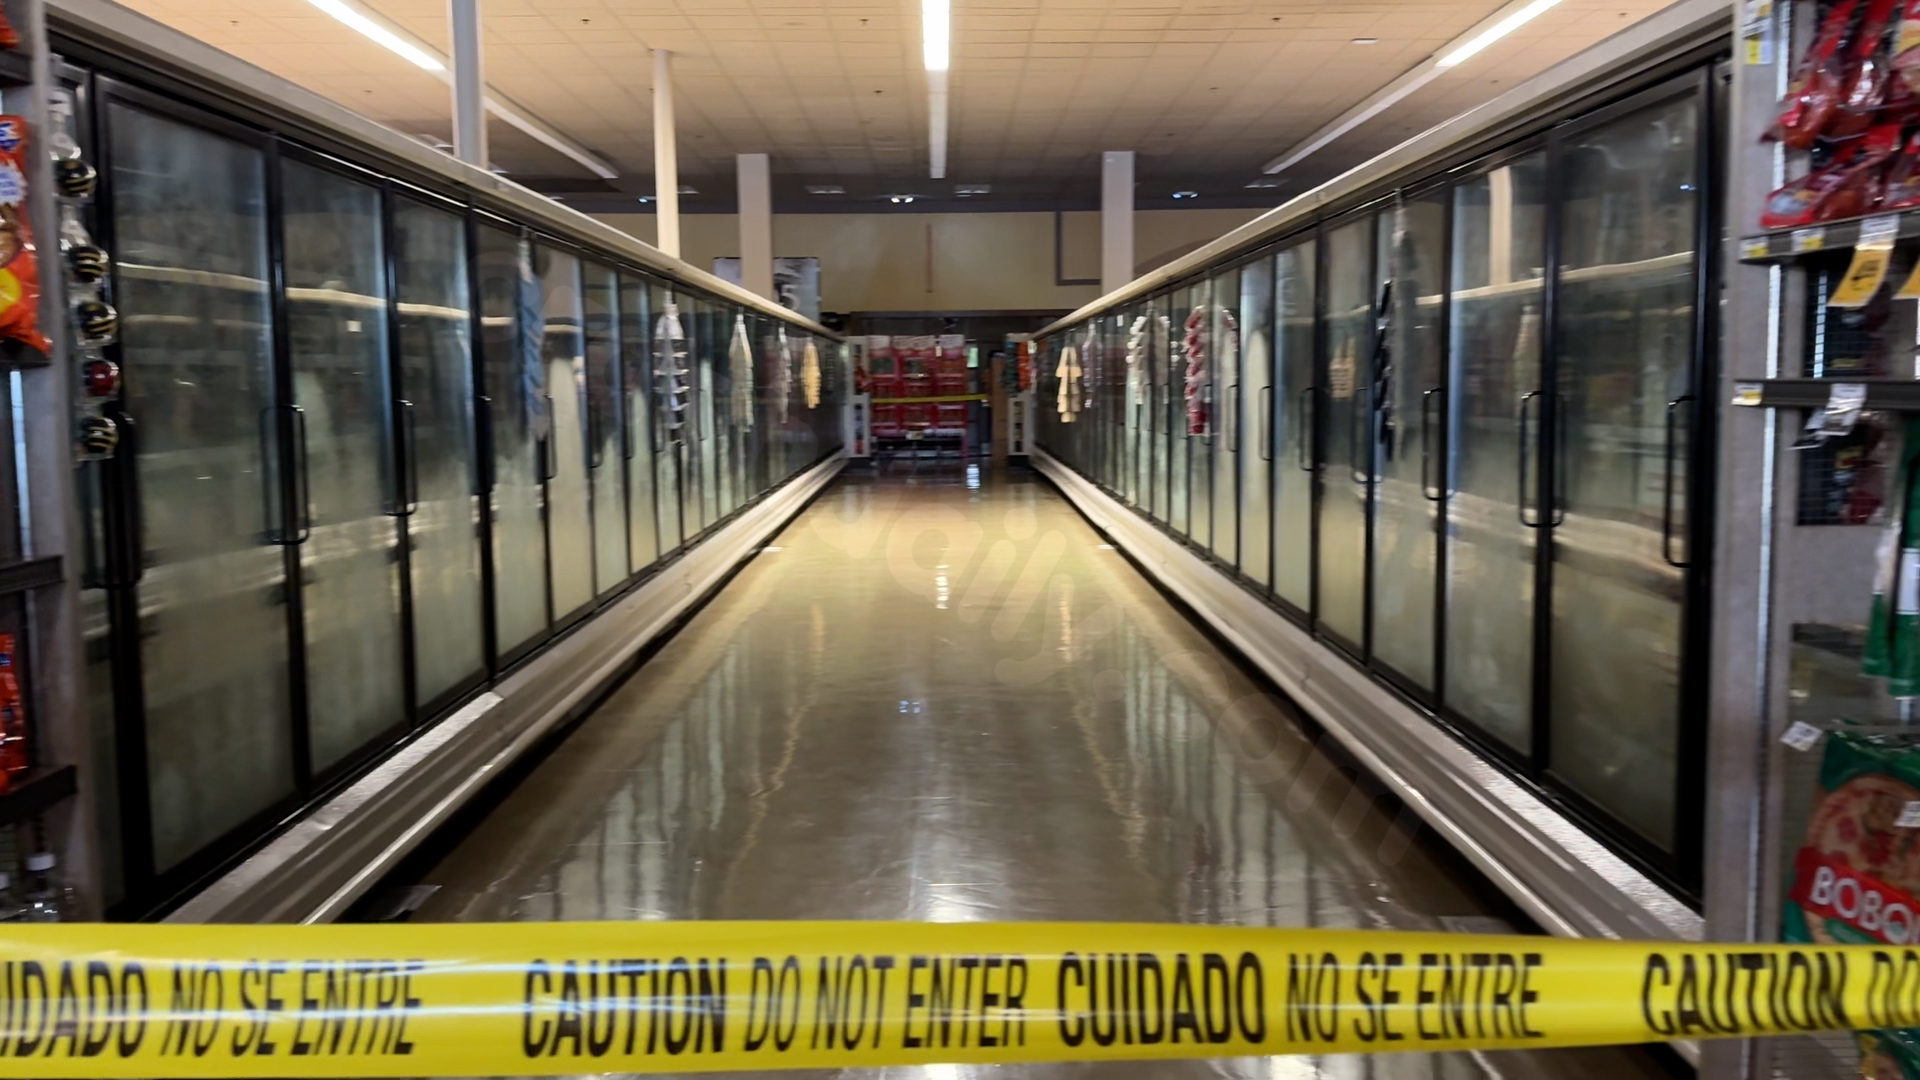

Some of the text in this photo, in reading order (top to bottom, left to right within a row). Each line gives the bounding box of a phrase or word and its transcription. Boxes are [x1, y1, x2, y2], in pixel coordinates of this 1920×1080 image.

[162, 962, 224, 1057] NO
[231, 960, 288, 1056] SE
[290, 959, 424, 1055] ENTRE
[522, 957, 727, 1058] CAUTION
[744, 955, 801, 1051] DO
[812, 955, 894, 1050] NOT
[902, 954, 1028, 1048] ENTER
[1057, 951, 1266, 1047] CUIDADO
[1287, 952, 1340, 1042] NO
[1354, 952, 1406, 1040] SE
[1416, 952, 1544, 1039] ENTRE
[1642, 952, 1855, 1035] CAUTION
